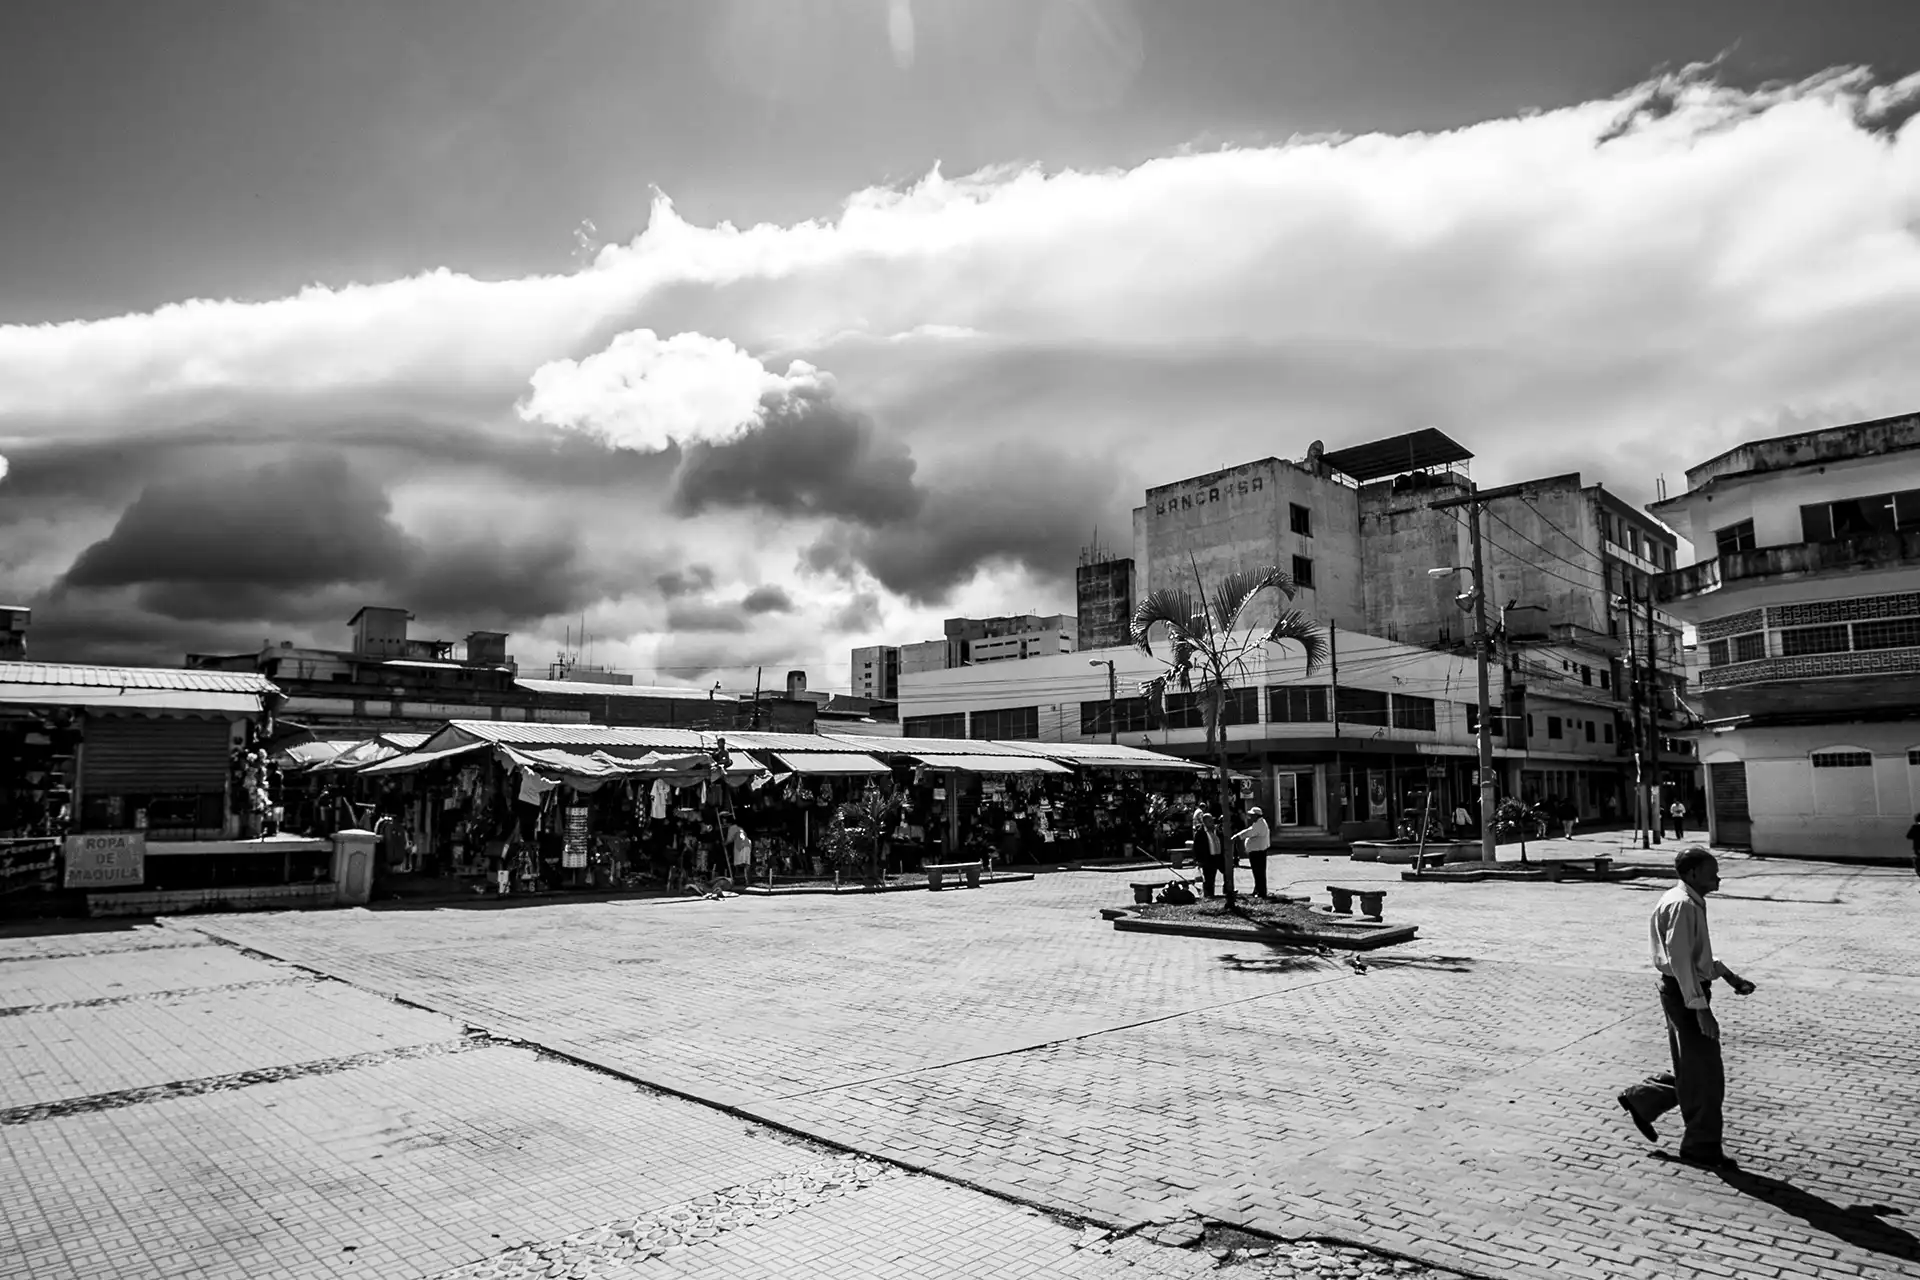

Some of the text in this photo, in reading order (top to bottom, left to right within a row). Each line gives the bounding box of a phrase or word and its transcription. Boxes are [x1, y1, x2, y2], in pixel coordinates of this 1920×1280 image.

[86, 837, 126, 850] ROPA
[96, 852, 116, 865] DE
[69, 867, 140, 881] MAQUILA
